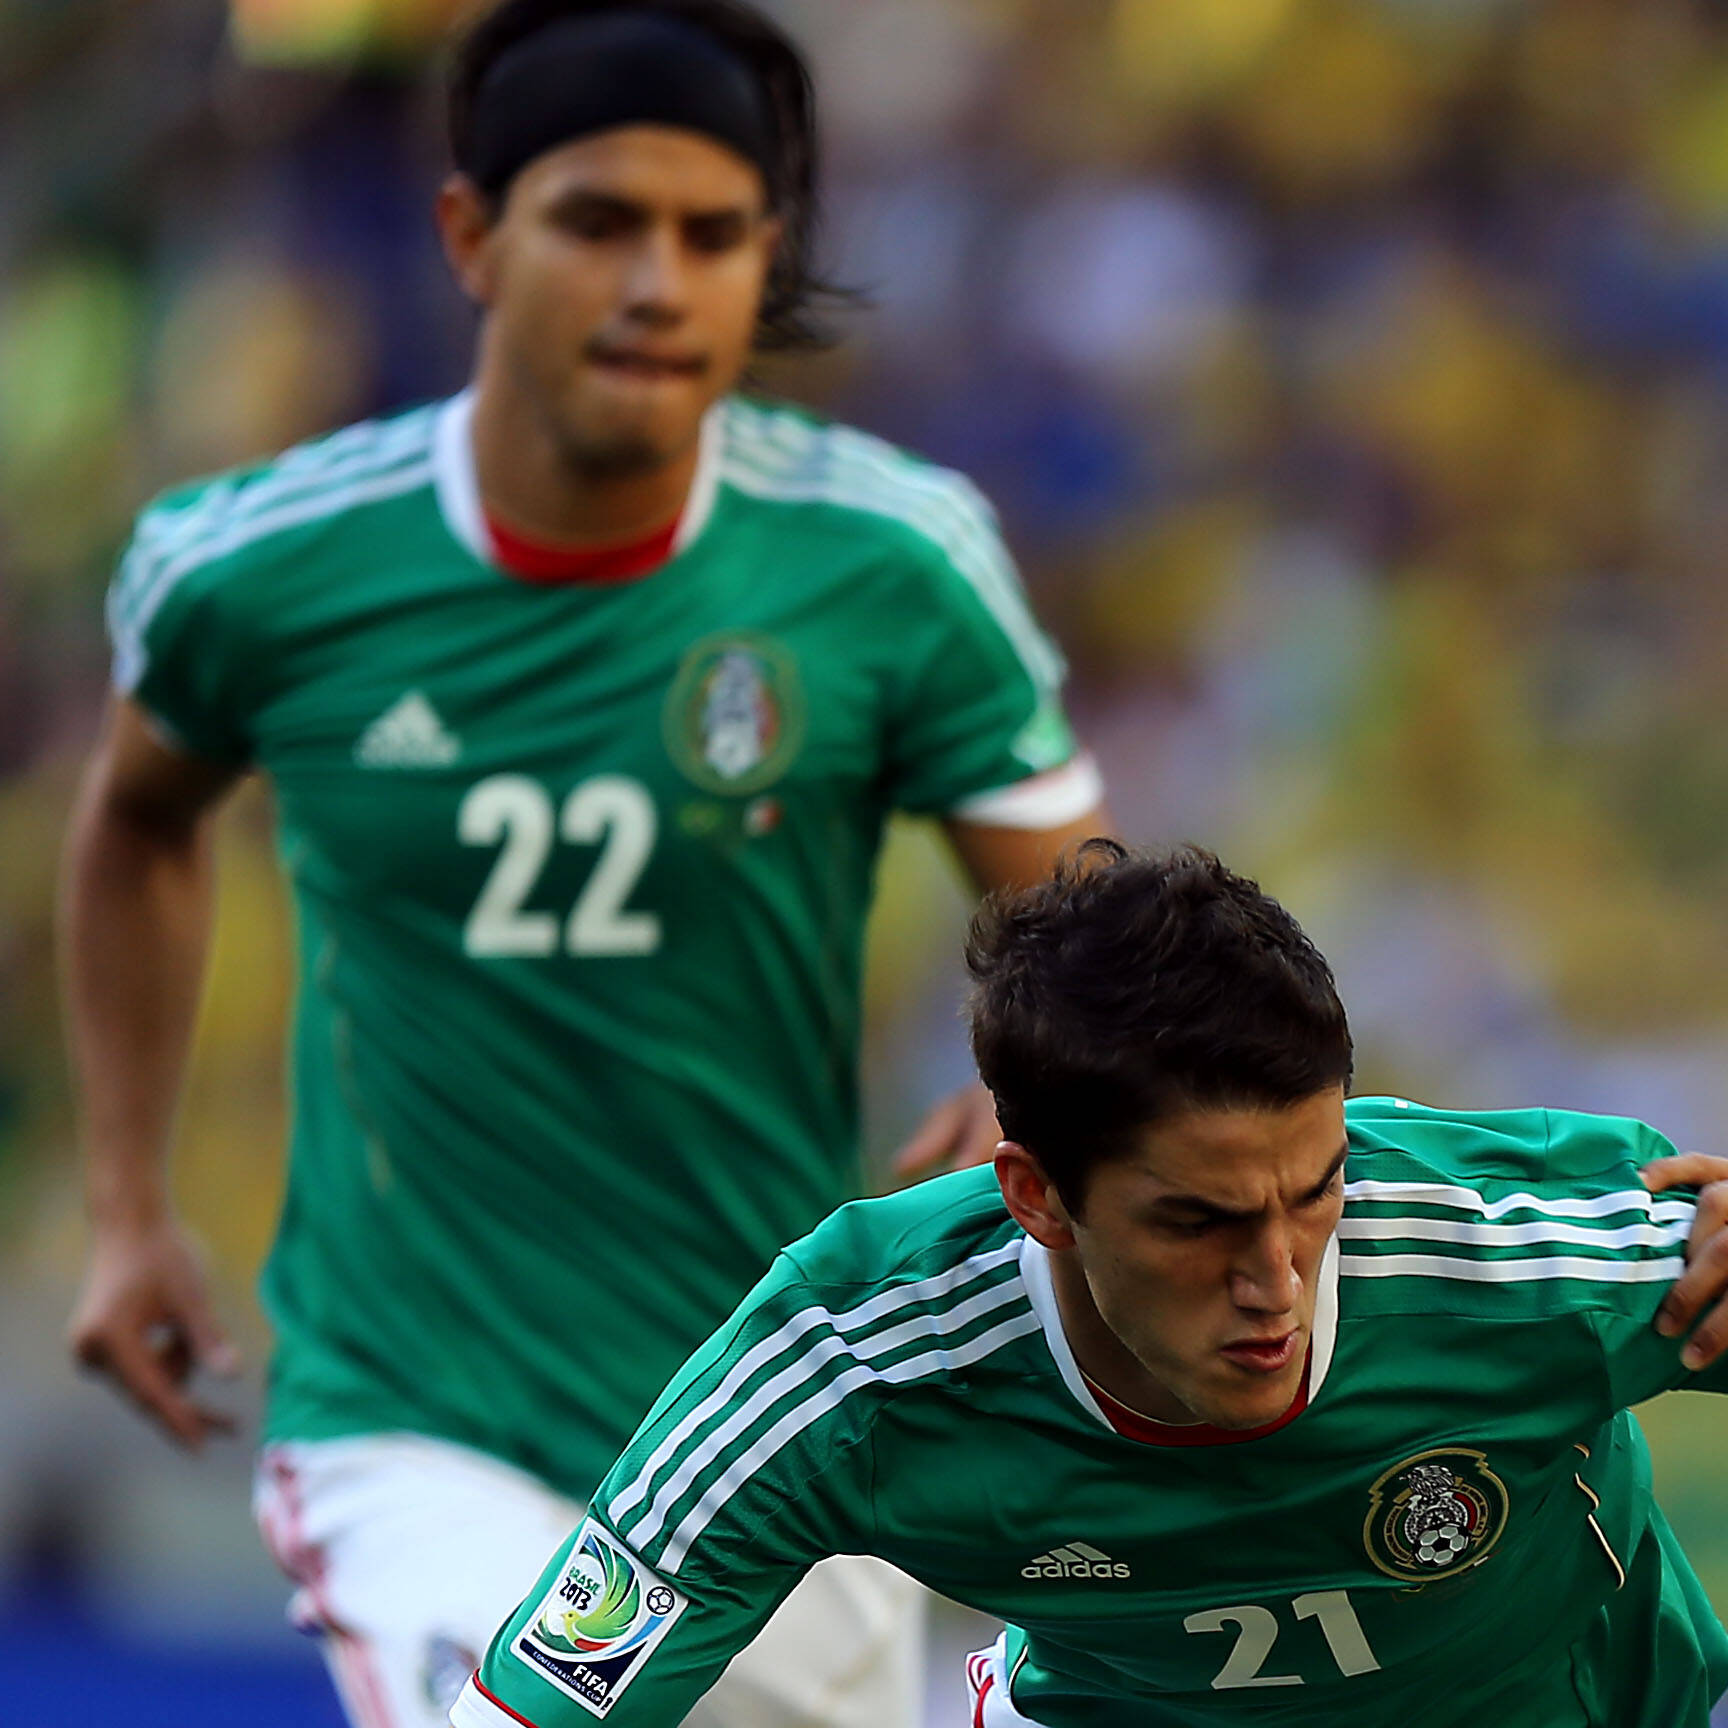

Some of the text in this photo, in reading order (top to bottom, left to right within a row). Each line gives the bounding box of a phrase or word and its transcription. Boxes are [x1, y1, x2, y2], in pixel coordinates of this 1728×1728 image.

[456, 772, 662, 958] 22
[1020, 1560, 1131, 1579] adidas
[559, 1576, 592, 1611] 2013
[1183, 1589, 1382, 1690] 21
[573, 1664, 608, 1697] FIFA
